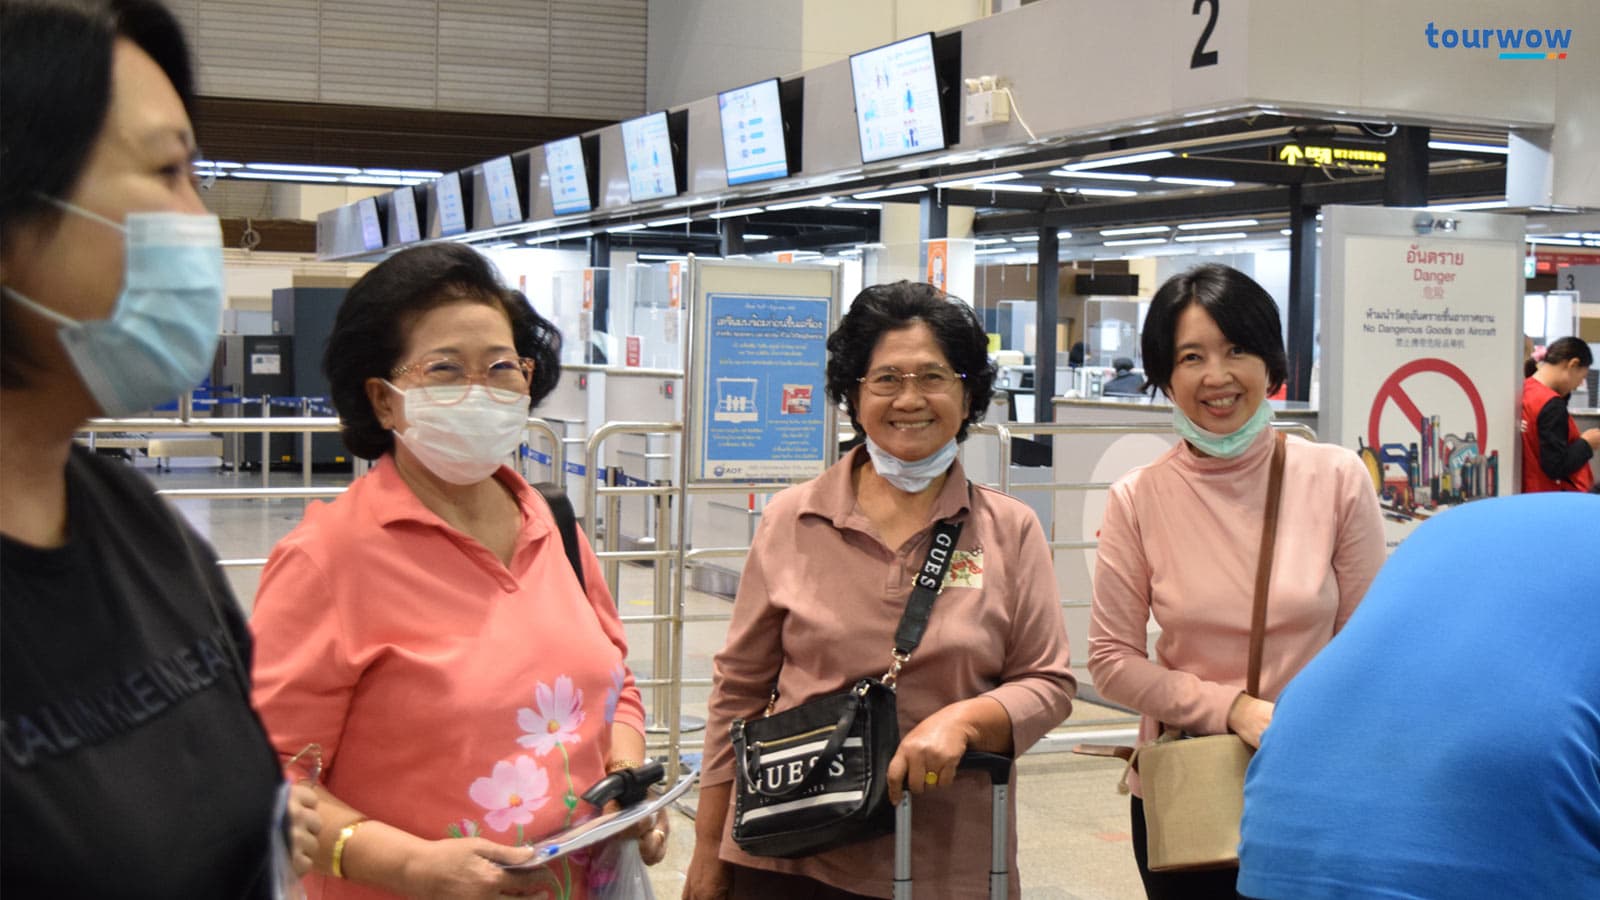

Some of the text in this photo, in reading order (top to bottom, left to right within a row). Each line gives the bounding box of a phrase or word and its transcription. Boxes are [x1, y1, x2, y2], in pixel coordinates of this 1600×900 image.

[1190, 0, 1219, 69] 2
[1434, 219, 1461, 231] AOT
[1406, 244, 1464, 266] อันตราย
[1413, 268, 1456, 285] Danger
[1566, 273, 1575, 290] 3
[1363, 323, 1496, 337] No Dangerous Goods on Aircraft
